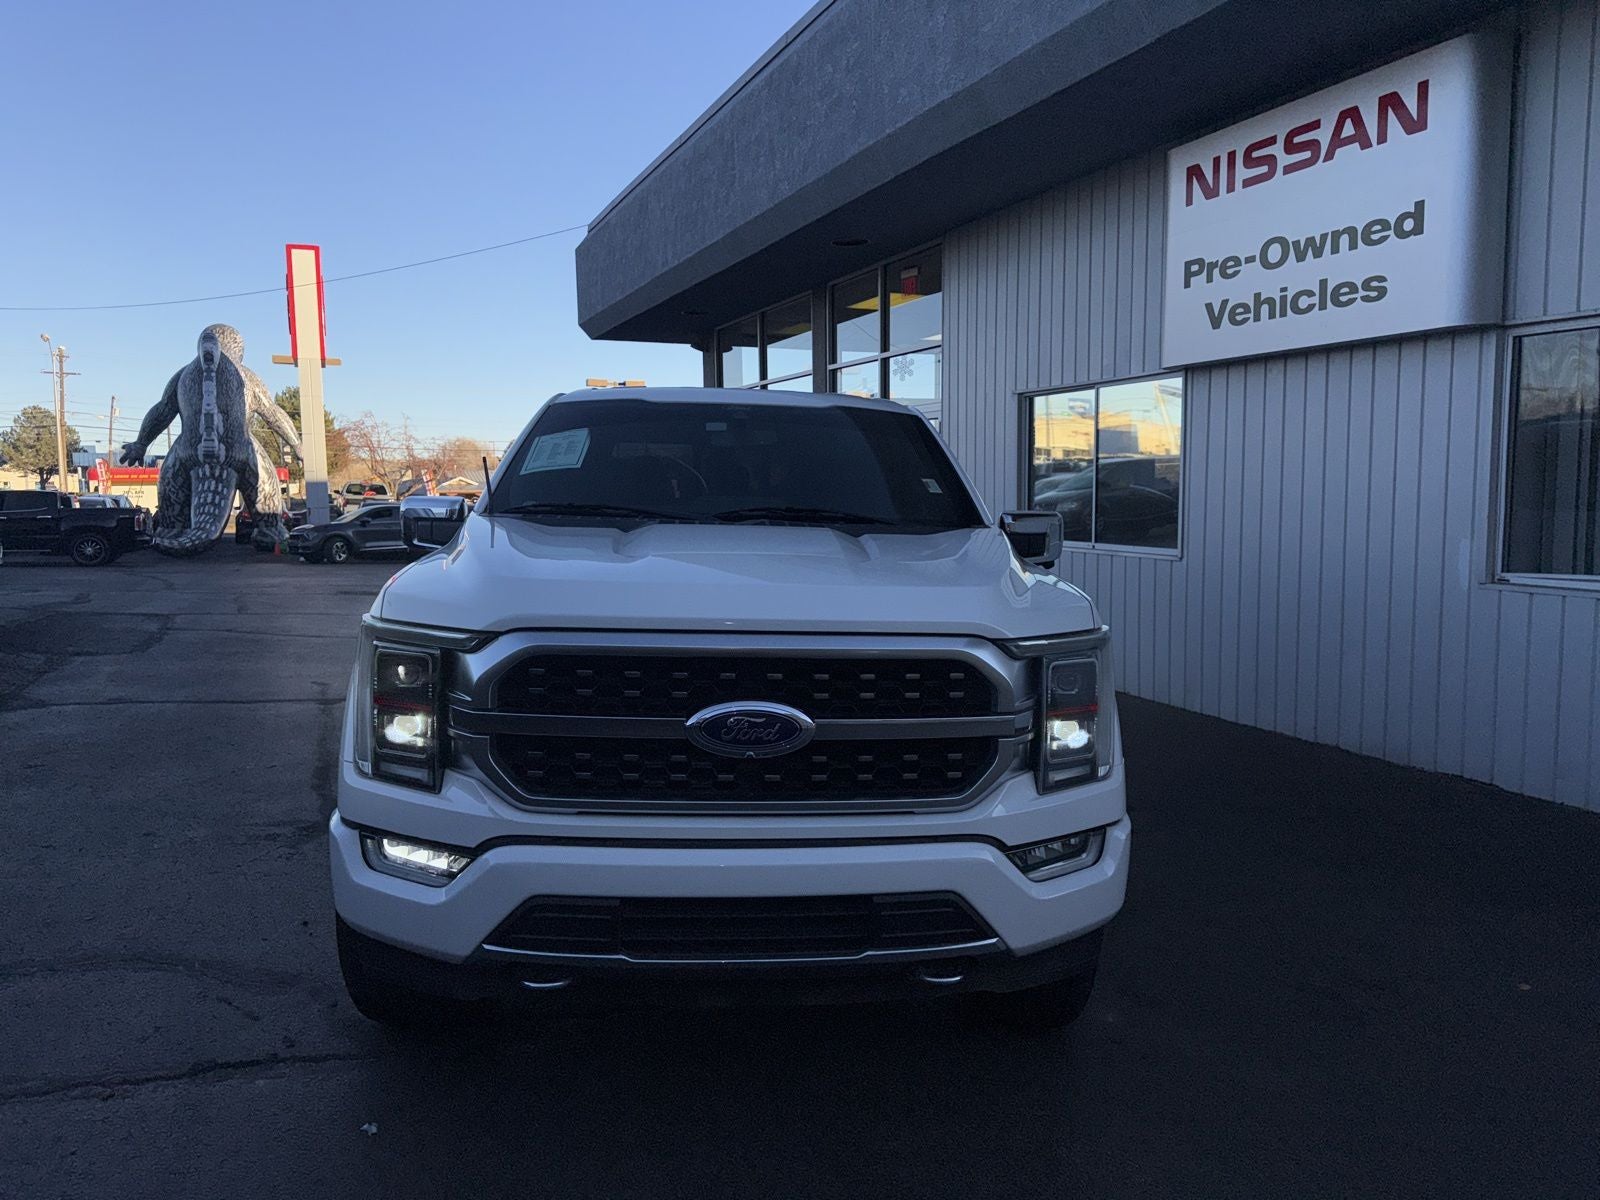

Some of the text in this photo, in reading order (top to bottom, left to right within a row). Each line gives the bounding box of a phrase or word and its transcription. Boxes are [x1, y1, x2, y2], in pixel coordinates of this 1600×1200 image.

[1186, 79, 1429, 207] NISSAN
[1184, 200, 1425, 288] Pre-Owned
[1205, 275, 1388, 329] Vehicles
[721, 716, 781, 740] Ford
